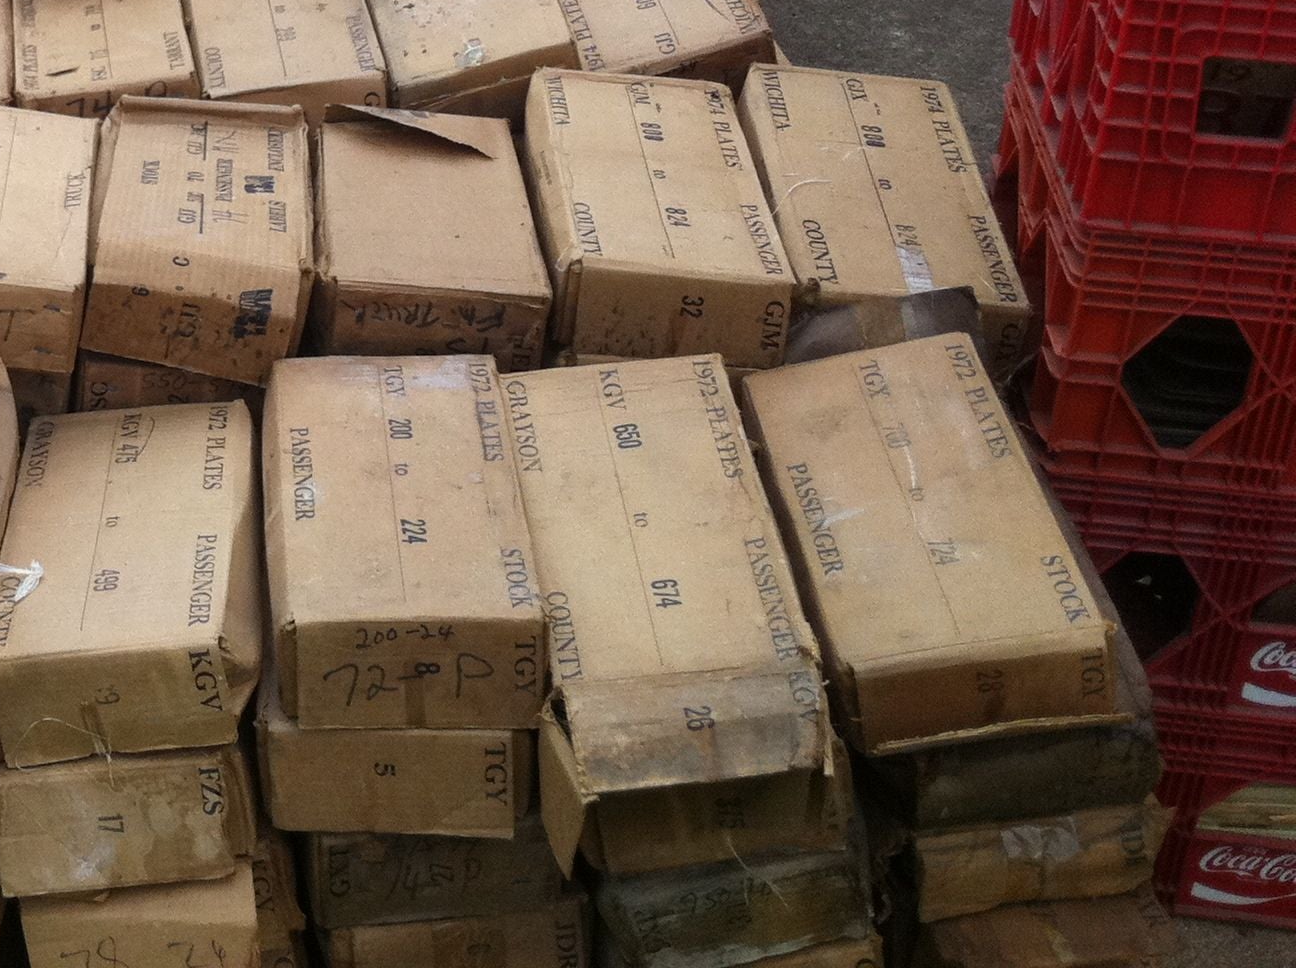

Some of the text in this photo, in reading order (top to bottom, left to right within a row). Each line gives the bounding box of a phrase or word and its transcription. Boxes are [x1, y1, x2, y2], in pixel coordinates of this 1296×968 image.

[844, 77, 870, 103] GJX
[62, 172, 86, 209] TRUCK
[141, 159, 161, 185] STOCK
[215, 158, 234, 202] PASSENGER
[543, 75, 605, 256] WICHITA COUNTY
[712, 120, 745, 172] PLATES
[738, 203, 785, 277] PASSENGER
[761, 70, 840, 286] WICHITA COUNTY
[918, 86, 1019, 304] 1974 PLATES PASSENGER
[268, 200, 288, 233] LABELS
[663, 205, 693, 229] 824
[678, 294, 706, 320] 32
[760, 299, 785, 353] GJM
[23, 419, 56, 488] GRAYSON
[288, 426, 317, 523] PASSENGER
[381, 363, 429, 546] TGY 200 to 224
[467, 360, 534, 611] 1972 PLATES STOCK
[858, 357, 961, 569] TGX 724
[943, 342, 1092, 626] 1972 PLATES STOCK
[92, 412, 144, 594] KGV 475 to 499
[187, 404, 230, 628] 1972 PLATES PASSENGER
[598, 368, 684, 610] KGV 650 674
[690, 360, 801, 664] 1972 PLATES PASSENGER
[785, 461, 846, 580] PASSENGER
[505, 379, 584, 684] GRAYSON COUNTY
[354, 620, 456, 651] 200-24
[511, 633, 539, 700] TGY
[188, 646, 225, 714] KGV
[681, 704, 716, 733] 26
[197, 764, 227, 818] FZS
[372, 762, 397, 778] 5
[483, 743, 509, 807] TGY
[96, 811, 125, 834] 17
